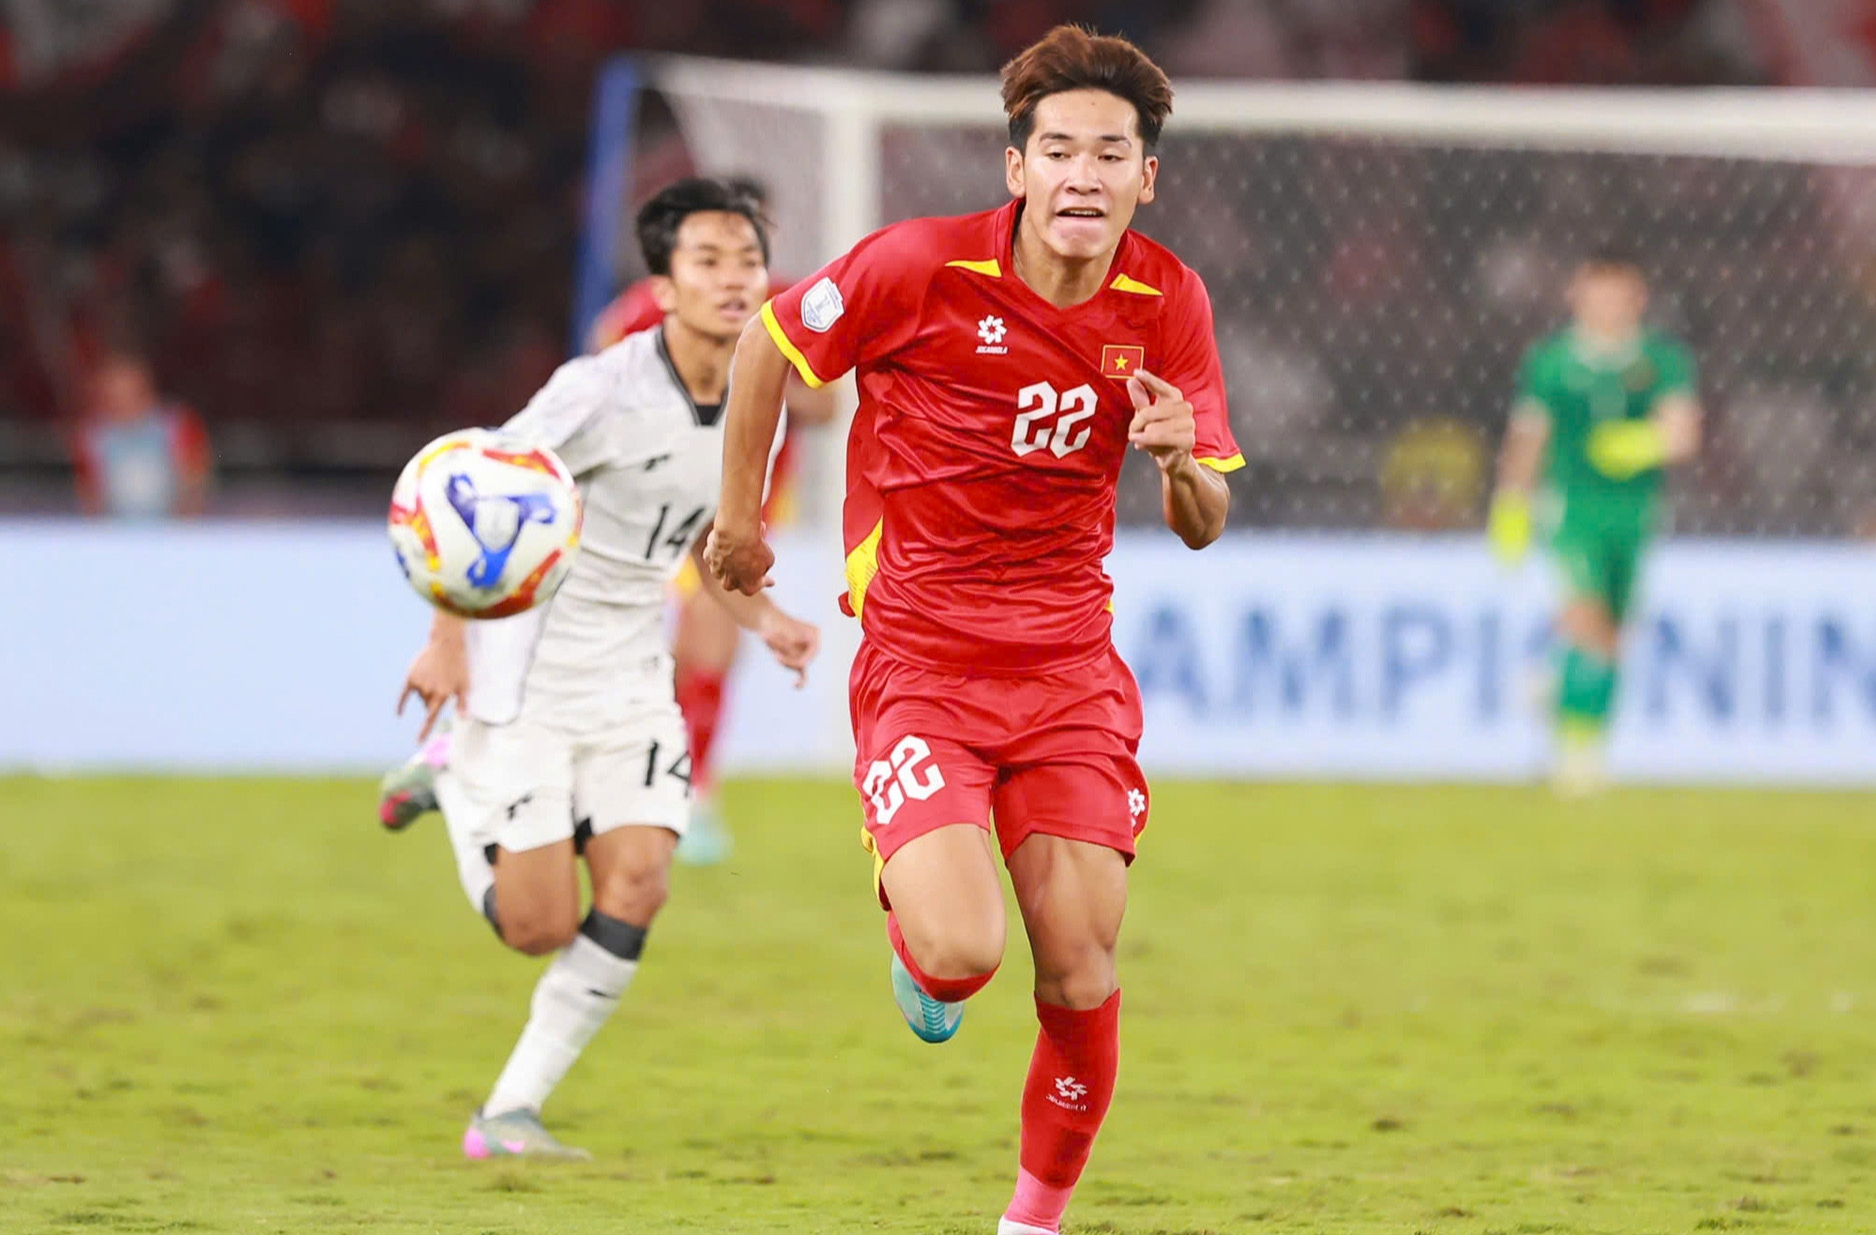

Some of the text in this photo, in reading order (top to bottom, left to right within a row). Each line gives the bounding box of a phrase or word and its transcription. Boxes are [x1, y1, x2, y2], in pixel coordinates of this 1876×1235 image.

[1011, 380, 1098, 459] 22
[645, 504, 705, 560] 14
[1130, 605, 1876, 726] AMPININ
[644, 740, 694, 799] 14
[862, 734, 946, 824] 22
